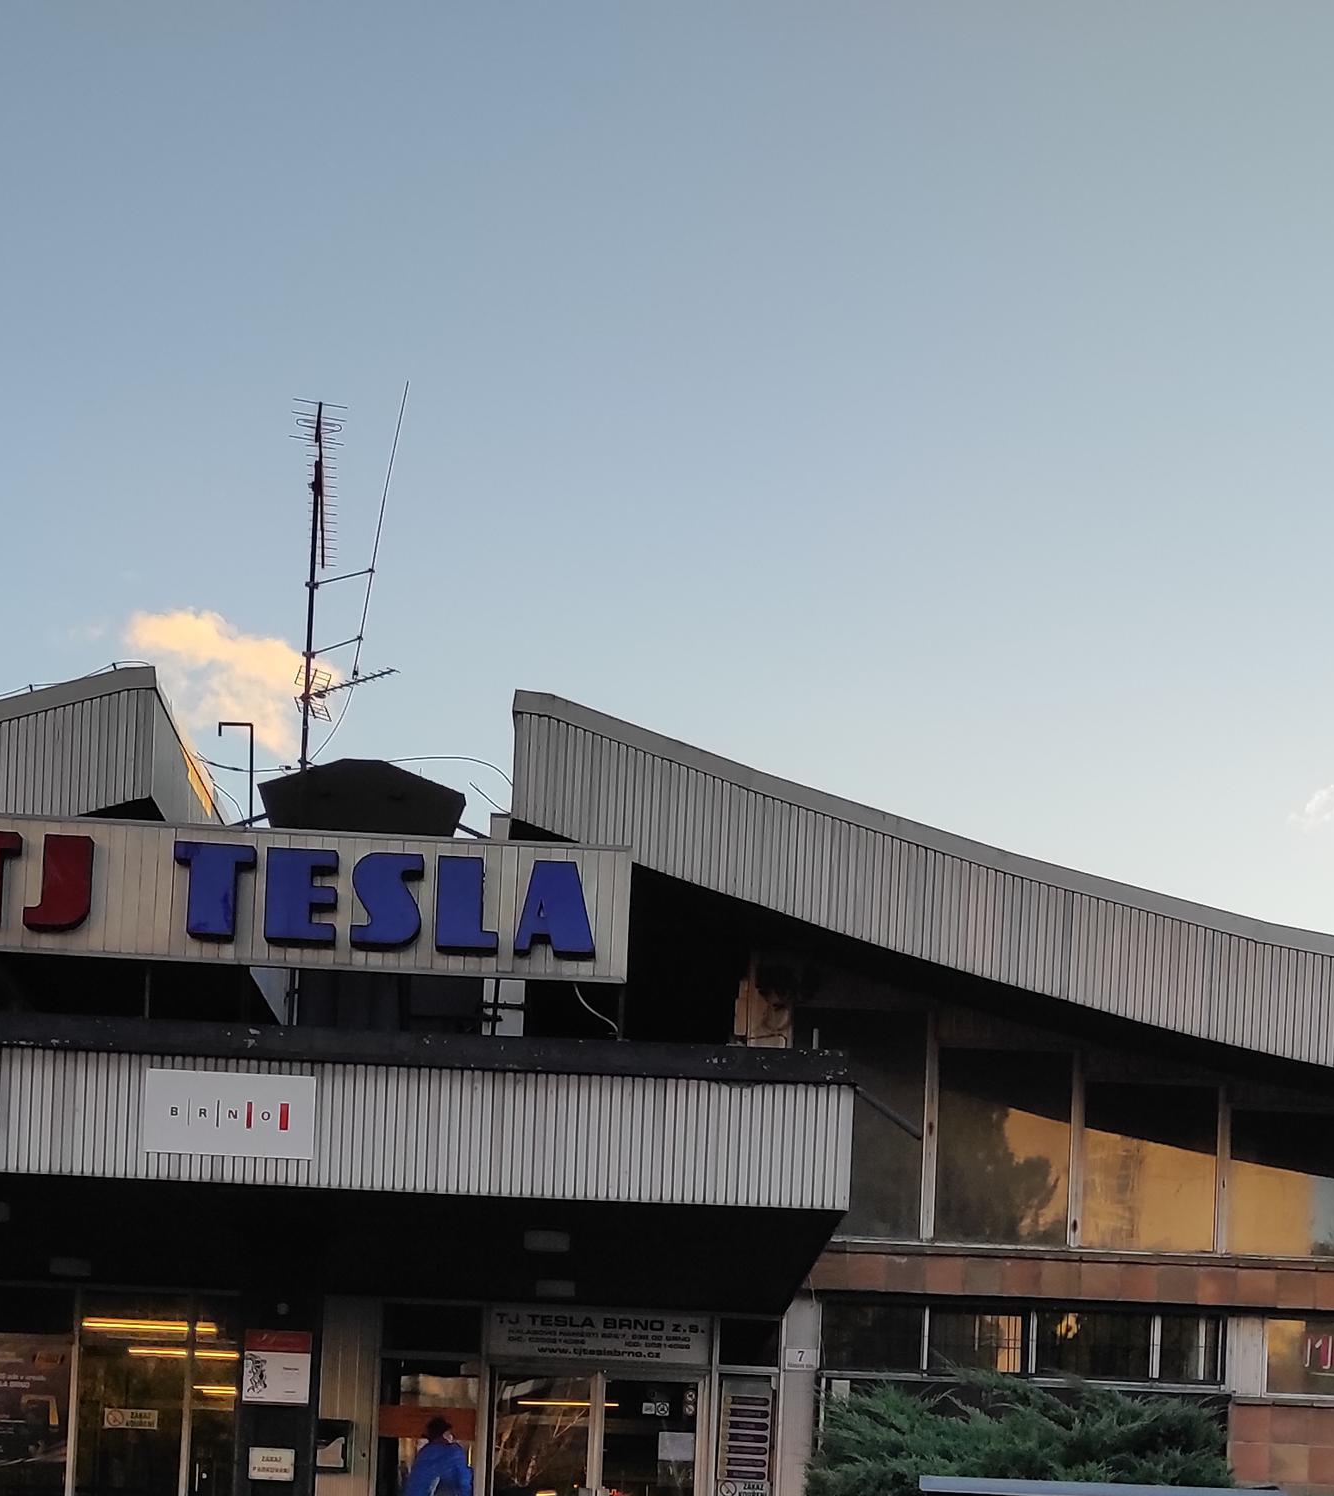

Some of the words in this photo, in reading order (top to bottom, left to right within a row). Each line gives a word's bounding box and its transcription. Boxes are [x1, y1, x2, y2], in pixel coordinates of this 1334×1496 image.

[175, 840, 596, 960] TESLA
[495, 1313, 520, 1325] TJ
[527, 1314, 596, 1328] TESLA
[603, 1317, 665, 1331] BRNO
[798, 1351, 805, 1362] 7
